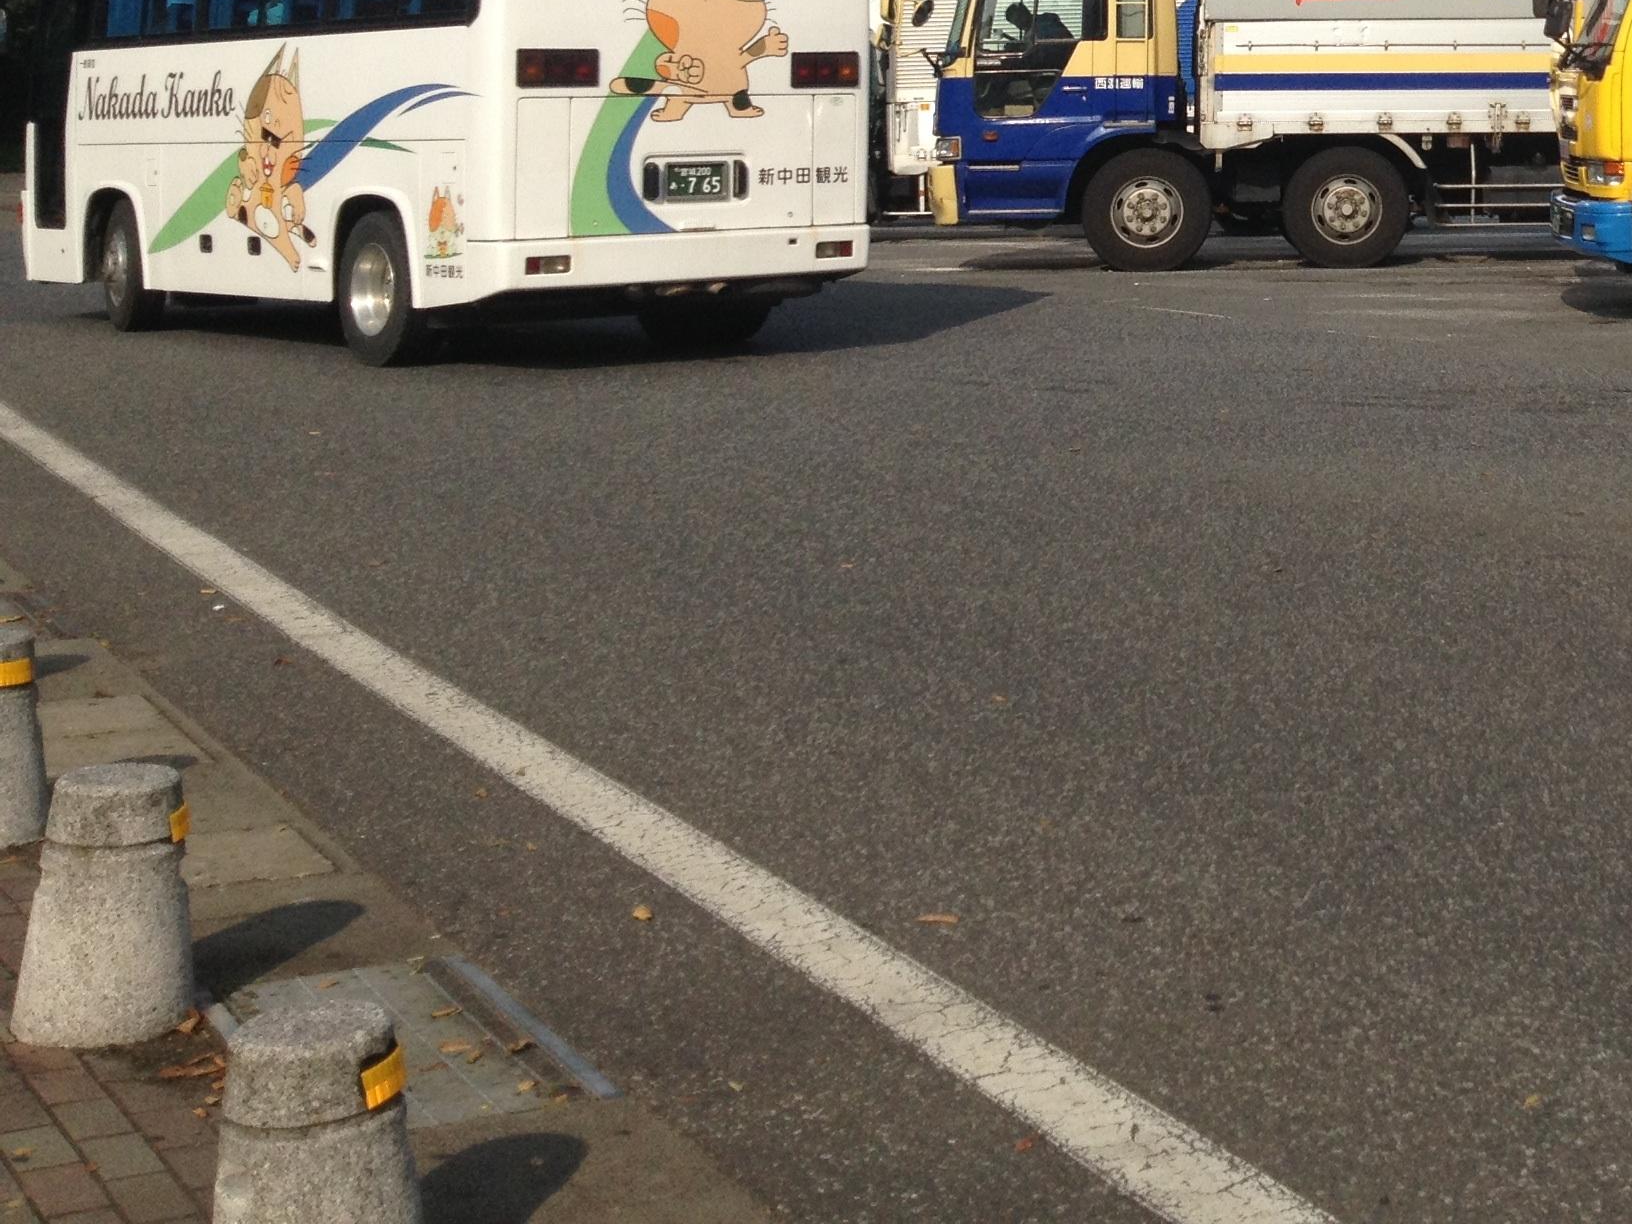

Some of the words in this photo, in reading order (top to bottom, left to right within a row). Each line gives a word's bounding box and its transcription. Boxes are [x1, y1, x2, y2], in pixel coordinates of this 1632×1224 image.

[78, 73, 159, 121] Nakada
[161, 69, 236, 119] Kanko
[758, 166, 848, 186] 新中田観光
